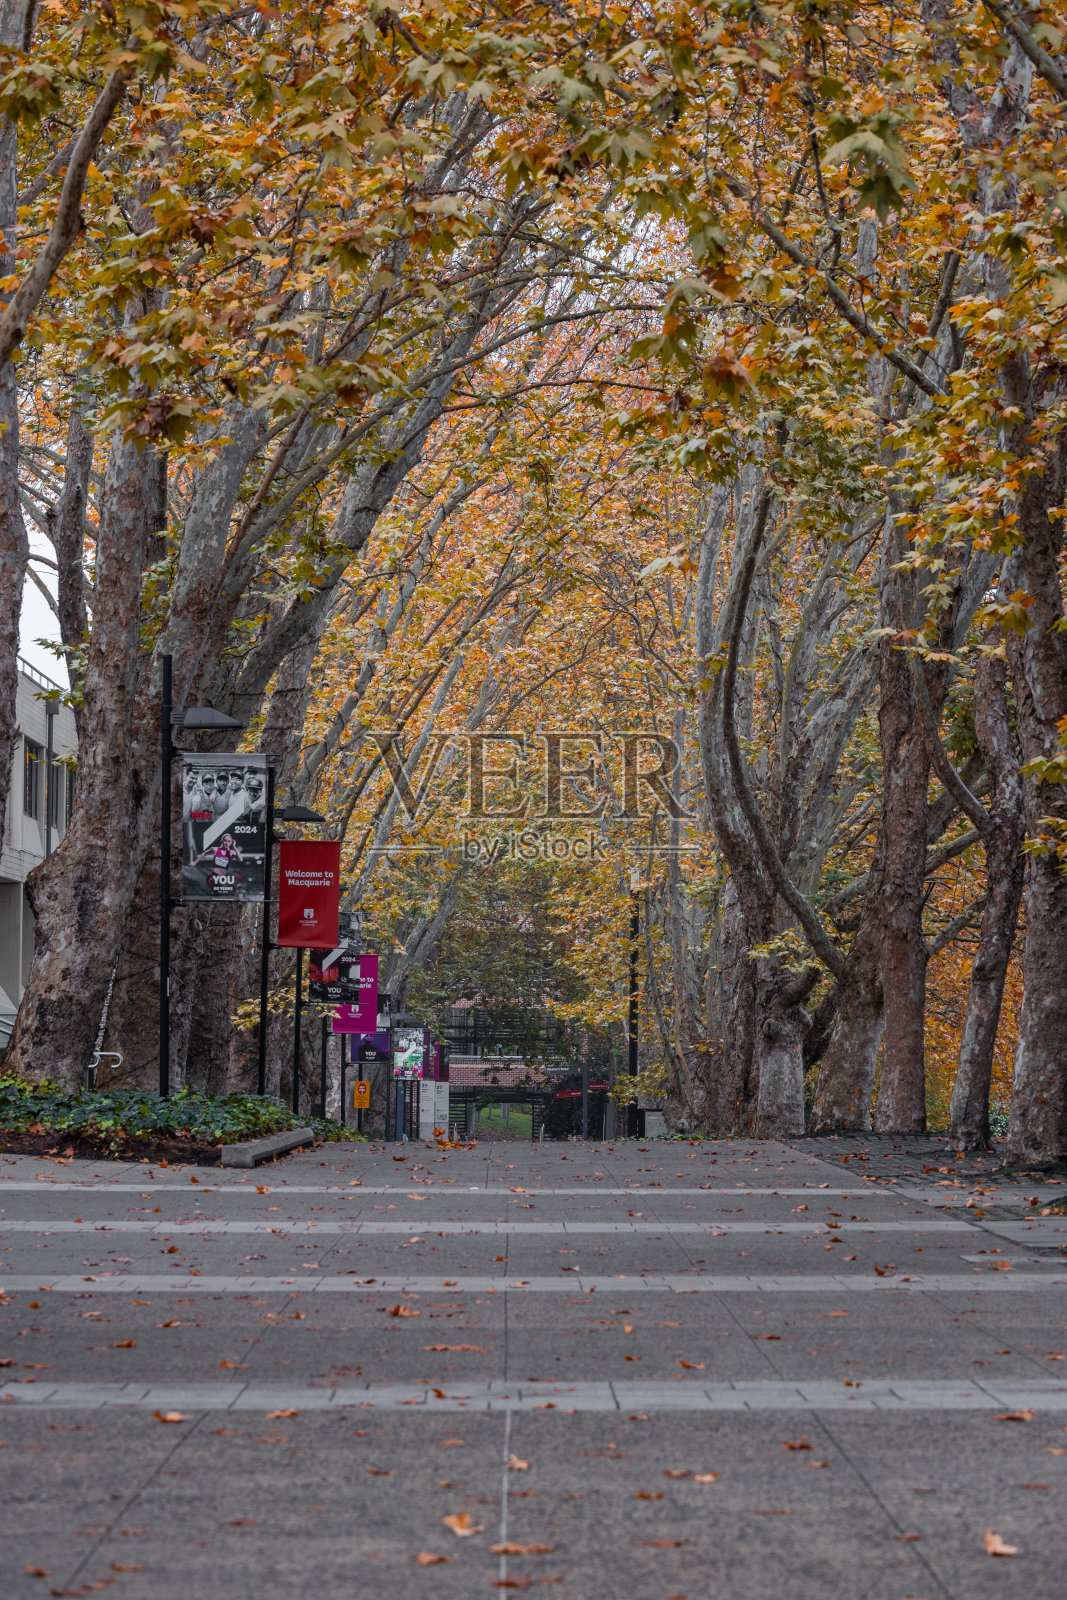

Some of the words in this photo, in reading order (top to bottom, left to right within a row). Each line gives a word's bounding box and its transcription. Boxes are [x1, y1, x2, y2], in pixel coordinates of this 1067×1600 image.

[190, 811, 211, 820] 1964
[234, 826, 258, 834] 2024
[285, 869, 323, 878] Welcome
[288, 878, 331, 888] Macquarie
